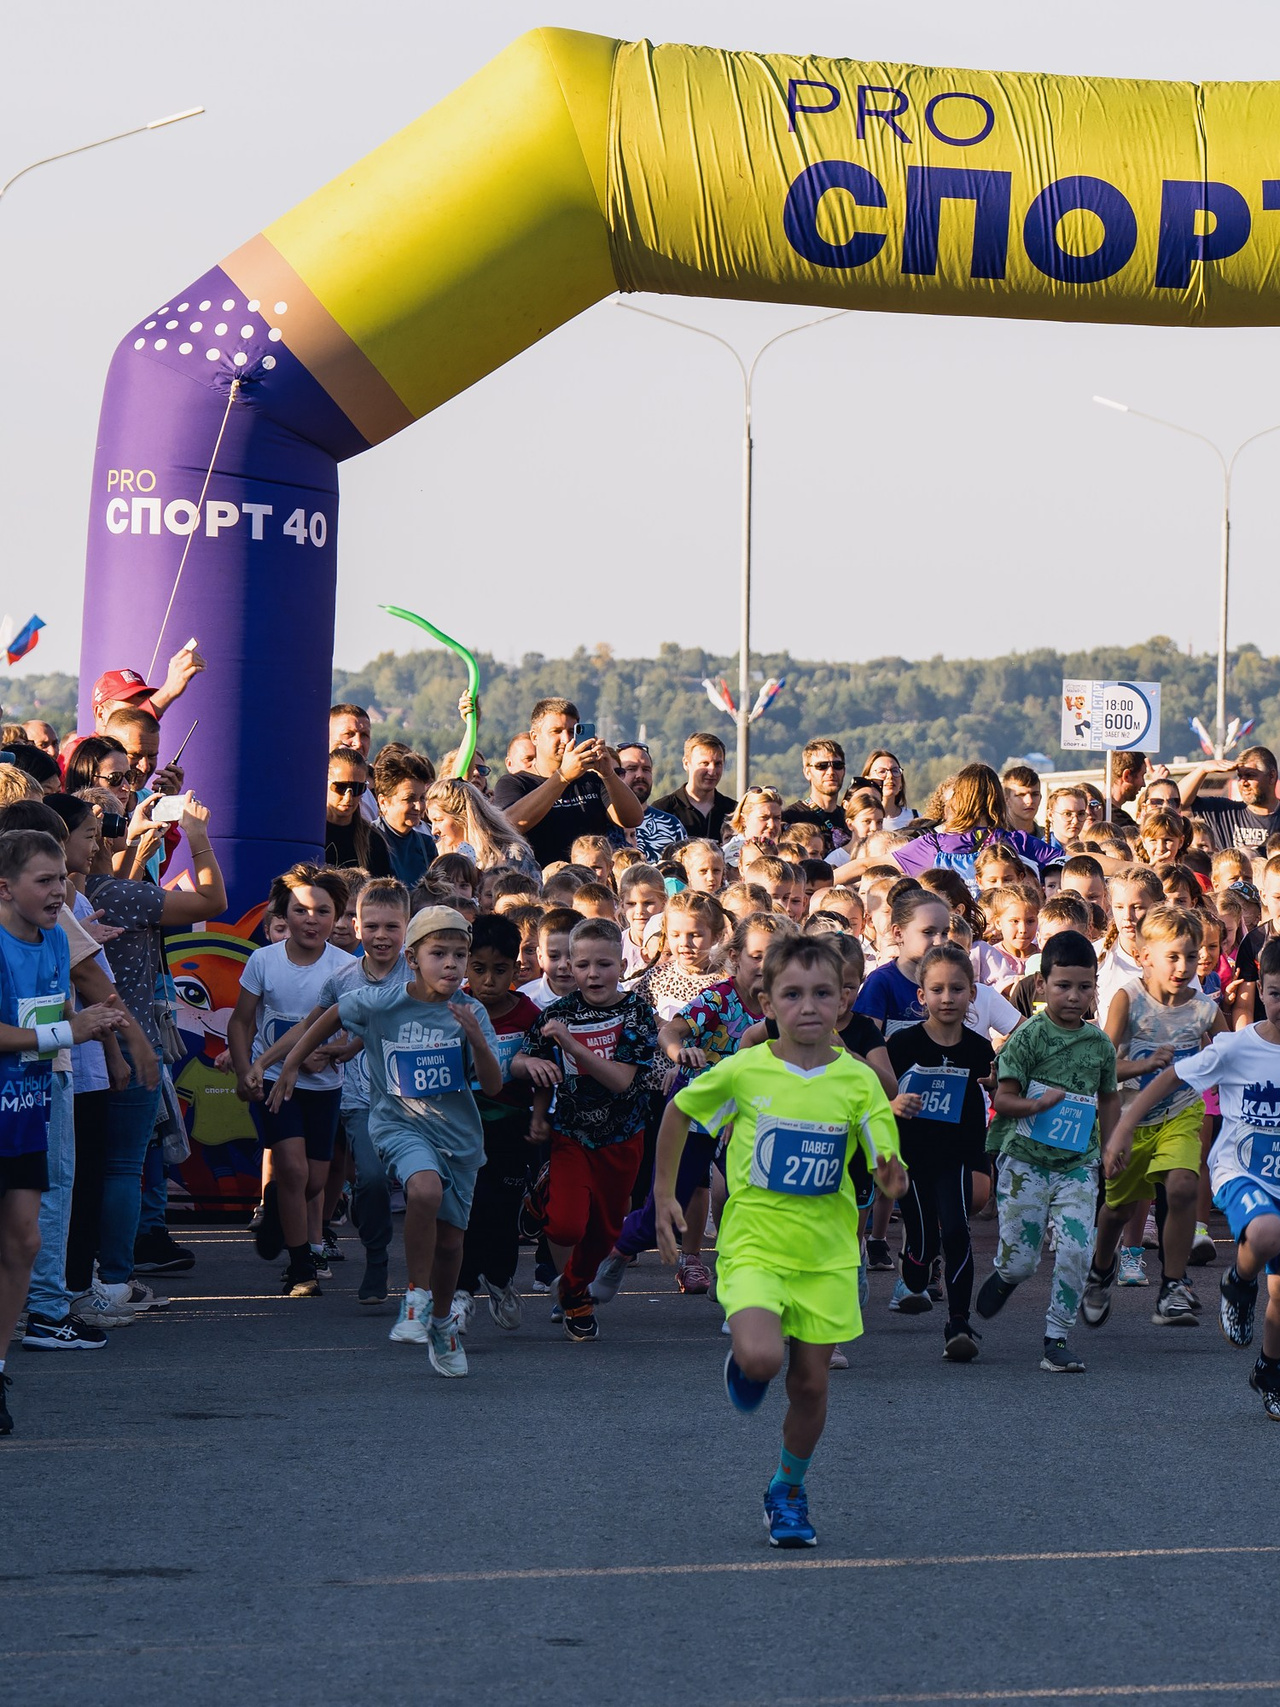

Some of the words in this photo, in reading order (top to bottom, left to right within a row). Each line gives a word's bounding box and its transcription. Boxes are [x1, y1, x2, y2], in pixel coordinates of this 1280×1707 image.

[787, 79, 995, 146] PRO
[107, 469, 156, 492] PRO
[106, 497, 273, 540] СПОРТ
[283, 508, 327, 547] 40
[1105, 700, 1133, 711] 18:00
[416, 1055, 445, 1066] СИМОН
[414, 1066, 451, 1091] 826
[932, 1080, 945, 1089] ЕВА
[1048, 1118, 1081, 1144] 271
[801, 1140, 835, 1155] ПАВЕЛ
[783, 1155, 840, 1188] 2702
